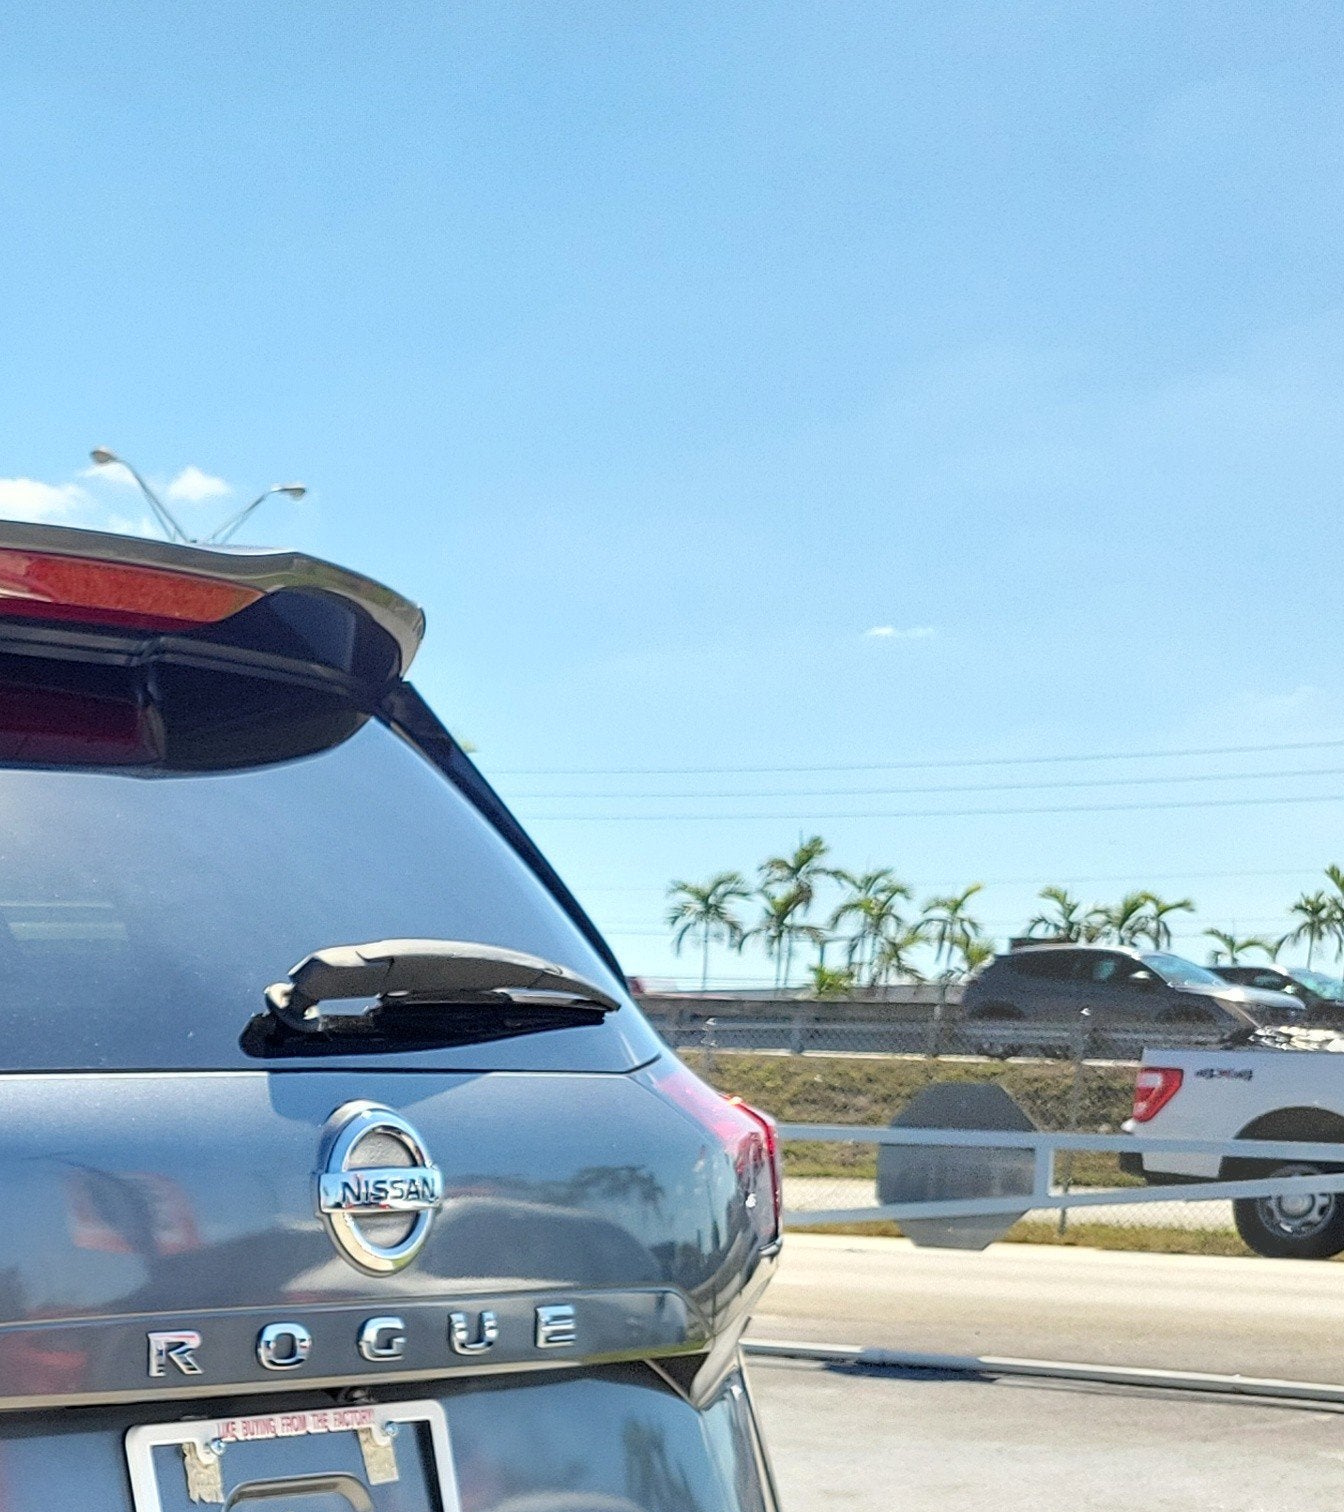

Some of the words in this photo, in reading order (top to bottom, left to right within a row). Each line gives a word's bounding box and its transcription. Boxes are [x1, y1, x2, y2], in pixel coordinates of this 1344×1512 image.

[341, 1174, 437, 1204] NISSAN
[146, 1303, 577, 1378] ROGUE
[241, 1418, 276, 1437] BUYING
[280, 1415, 306, 1433] FROM
[311, 1413, 329, 1430] THE
